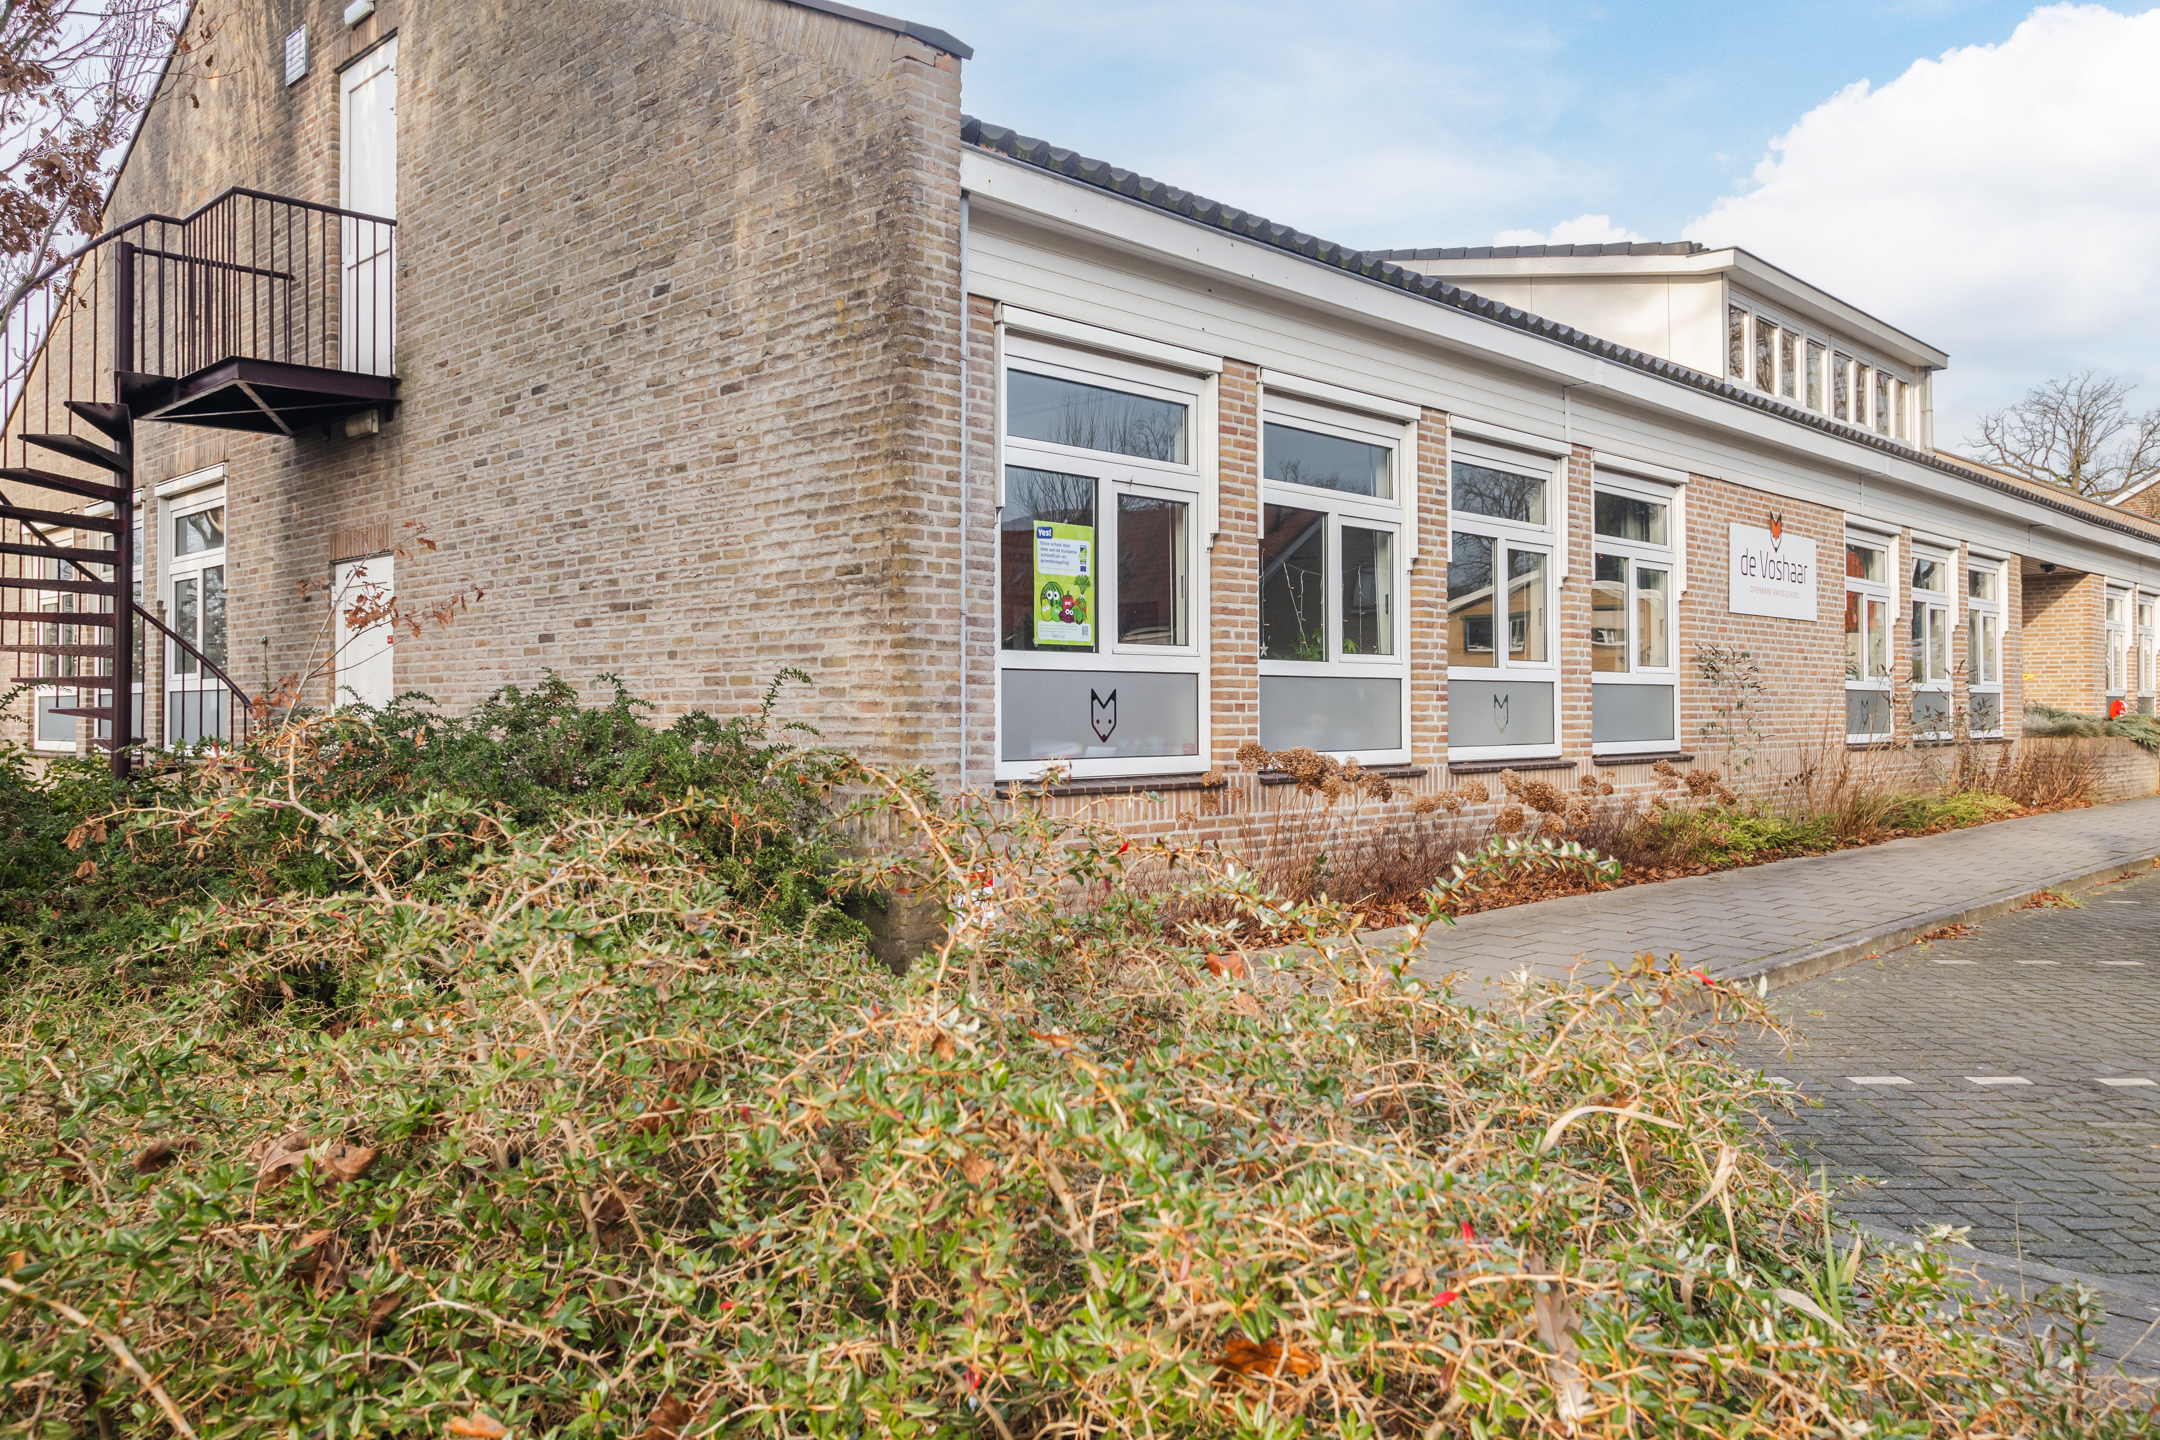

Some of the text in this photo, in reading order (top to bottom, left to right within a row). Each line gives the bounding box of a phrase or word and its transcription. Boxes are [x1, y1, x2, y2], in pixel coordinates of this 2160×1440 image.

[1038, 529, 1052, 537] Yes!
[1741, 548, 1807, 584] de Voshaar
[1750, 586, 1800, 599] OPENBARE BASISSCHOOL
